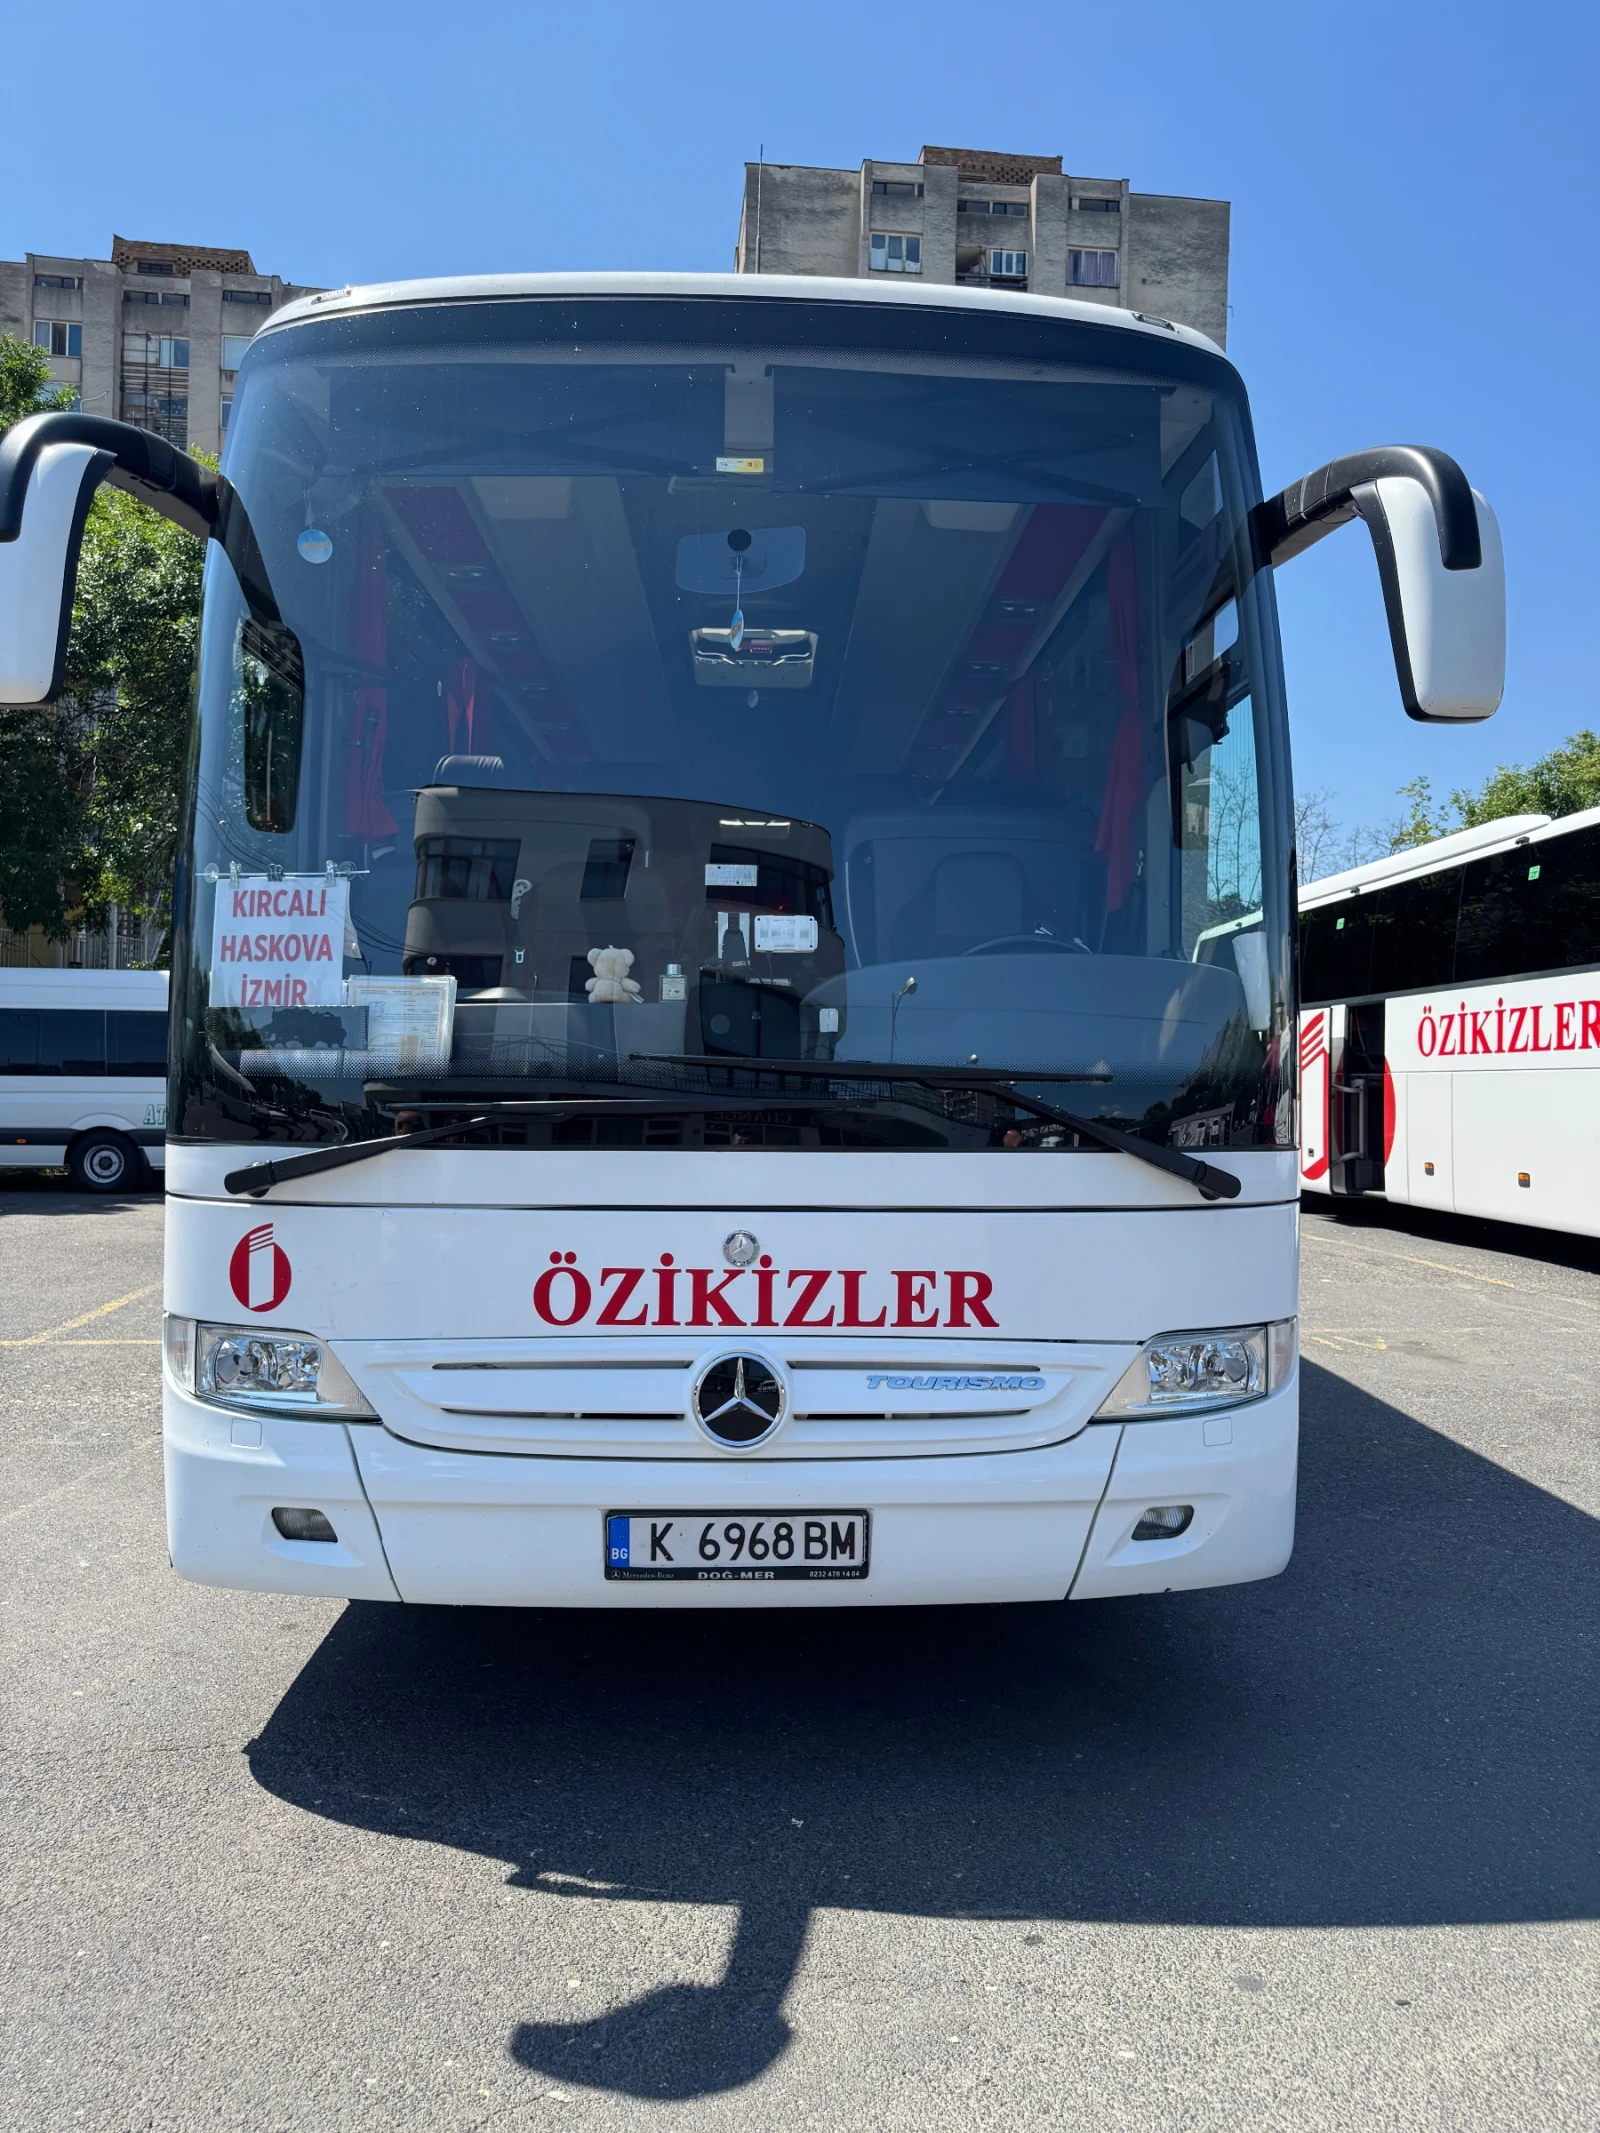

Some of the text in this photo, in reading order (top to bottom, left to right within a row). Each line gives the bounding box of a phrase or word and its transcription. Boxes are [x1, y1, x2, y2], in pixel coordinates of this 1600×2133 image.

[231, 889, 327, 918] KIRCALI
[220, 933, 334, 962] HASKOVA
[240, 973, 308, 1006] İZMİR
[1417, 997, 1600, 1057] ÖZİKİZLER
[533, 1251, 1000, 1328] ÖZİKİZLER
[866, 1375, 1046, 1391] TOURISMO
[611, 1548, 628, 1560] BG
[650, 1521, 855, 1561] K 6968 BM
[622, 1571, 675, 1579] Mercedes-Benz
